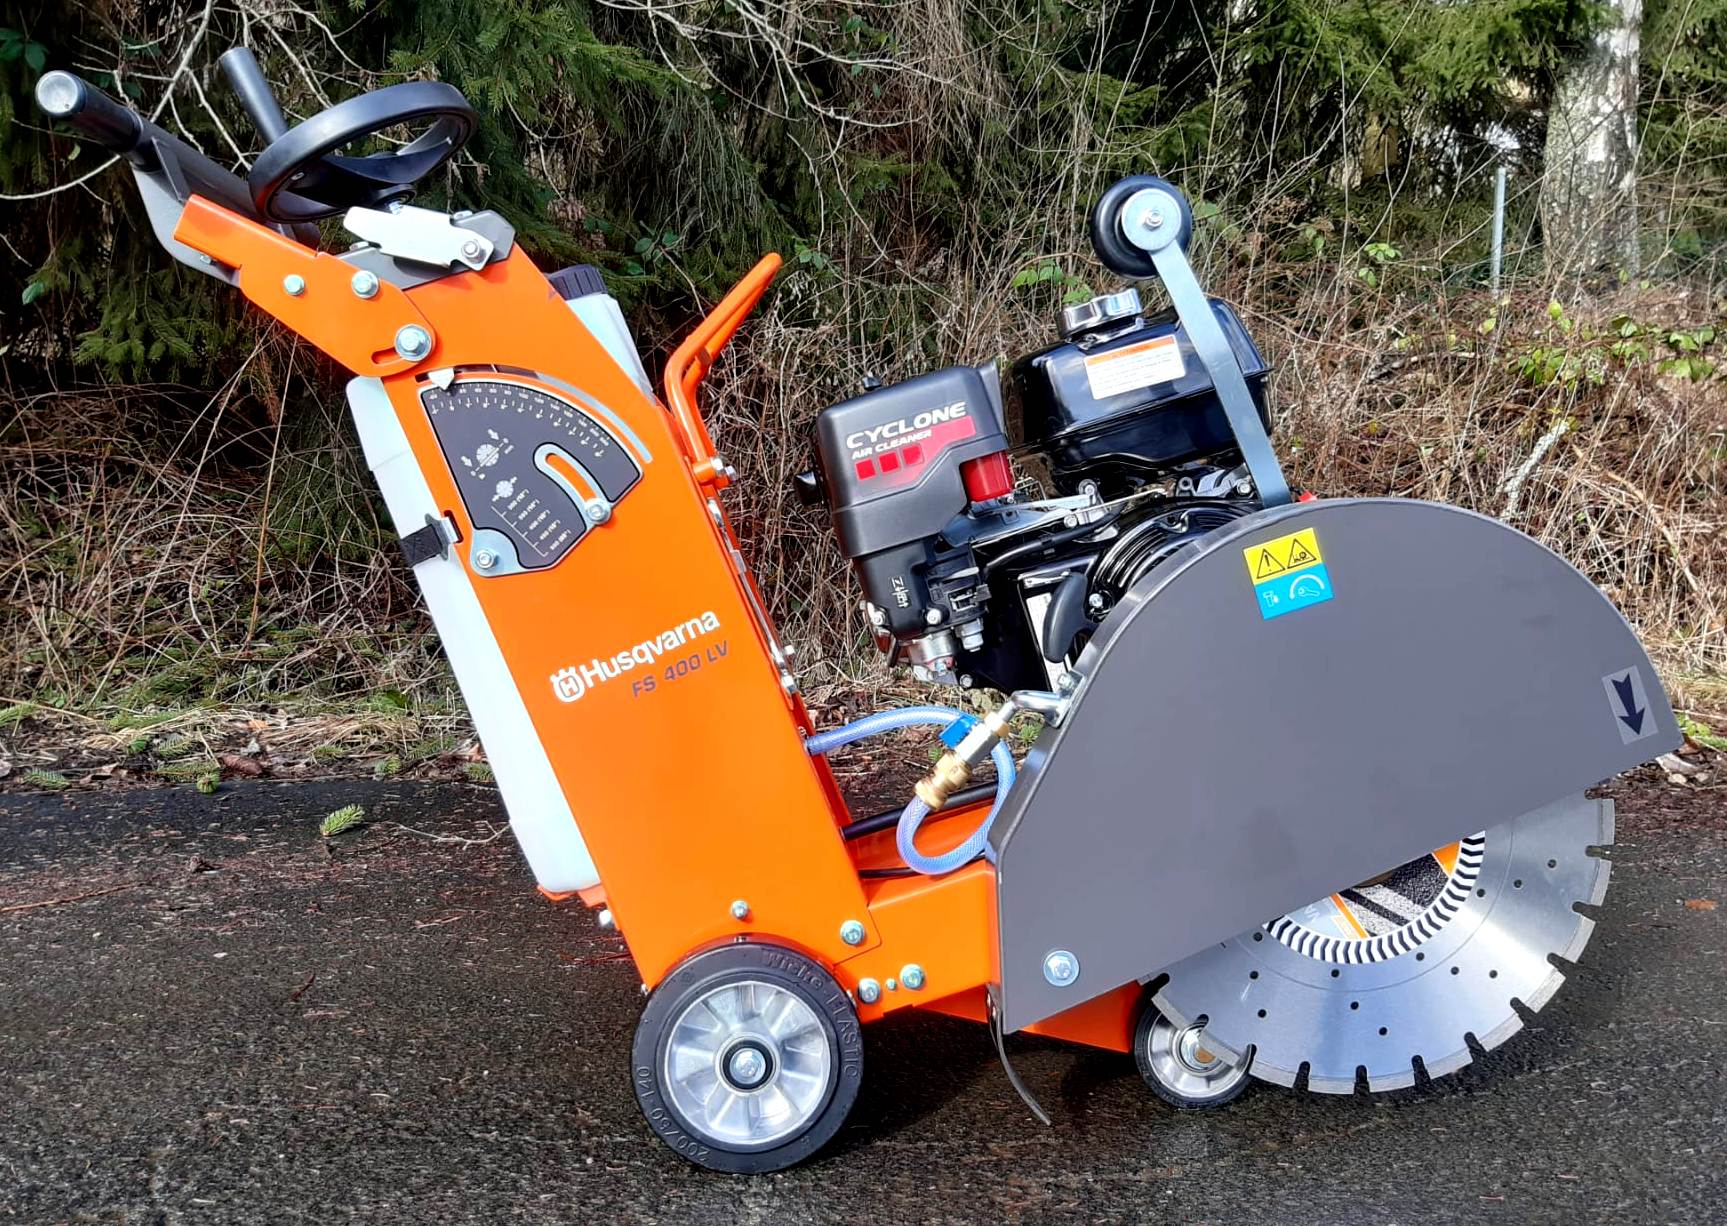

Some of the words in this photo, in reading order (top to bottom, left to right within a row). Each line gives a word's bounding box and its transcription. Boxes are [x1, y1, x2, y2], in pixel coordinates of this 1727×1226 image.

[846, 401, 967, 449] CYCLONE
[852, 445, 872, 460] AIR
[876, 430, 932, 452] CLEANER
[579, 610, 721, 688] Husqvarna
[631, 675, 656, 697] FS
[664, 654, 701, 681] 400
[706, 640, 728, 663] LV
